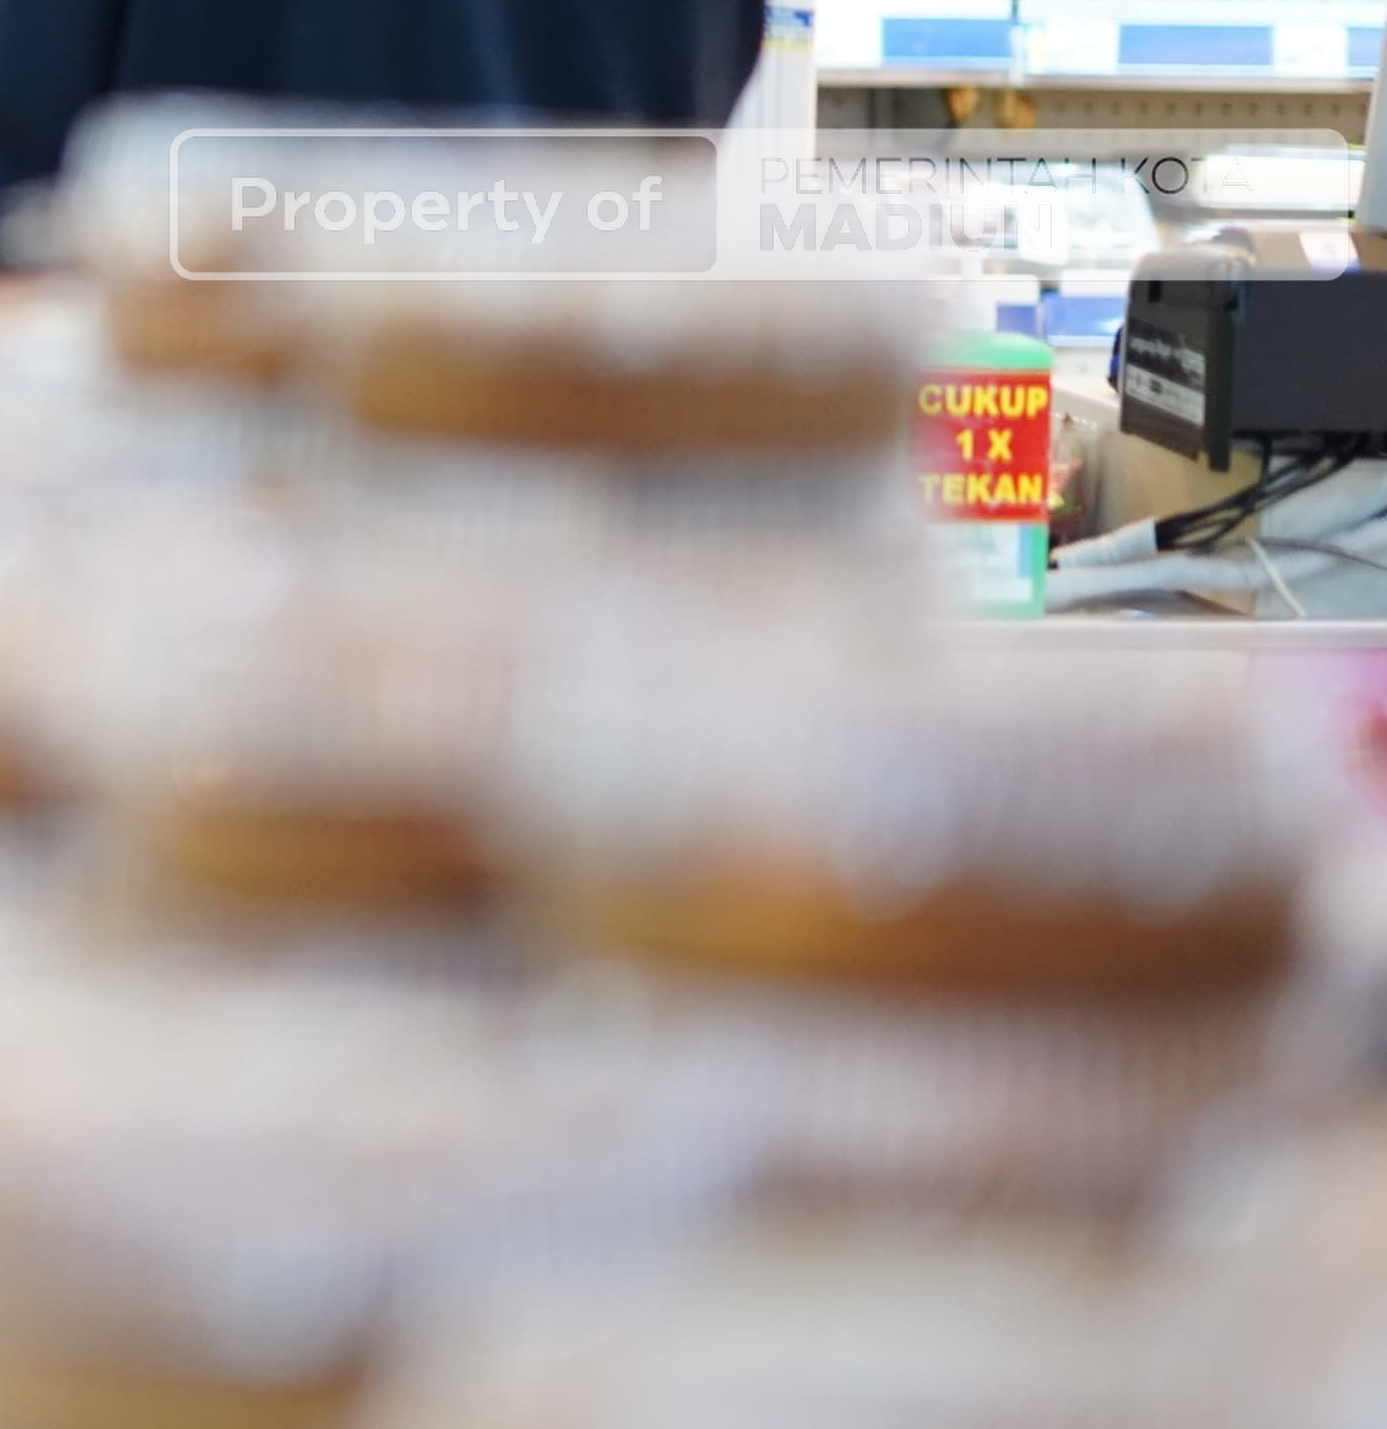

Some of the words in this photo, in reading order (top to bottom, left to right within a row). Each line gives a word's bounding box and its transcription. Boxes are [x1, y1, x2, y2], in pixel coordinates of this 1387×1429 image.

[918, 383, 1049, 418] CUKUP
[955, 428, 975, 462] 1
[986, 429, 1013, 461] X
[918, 473, 1043, 506] TEKAN
